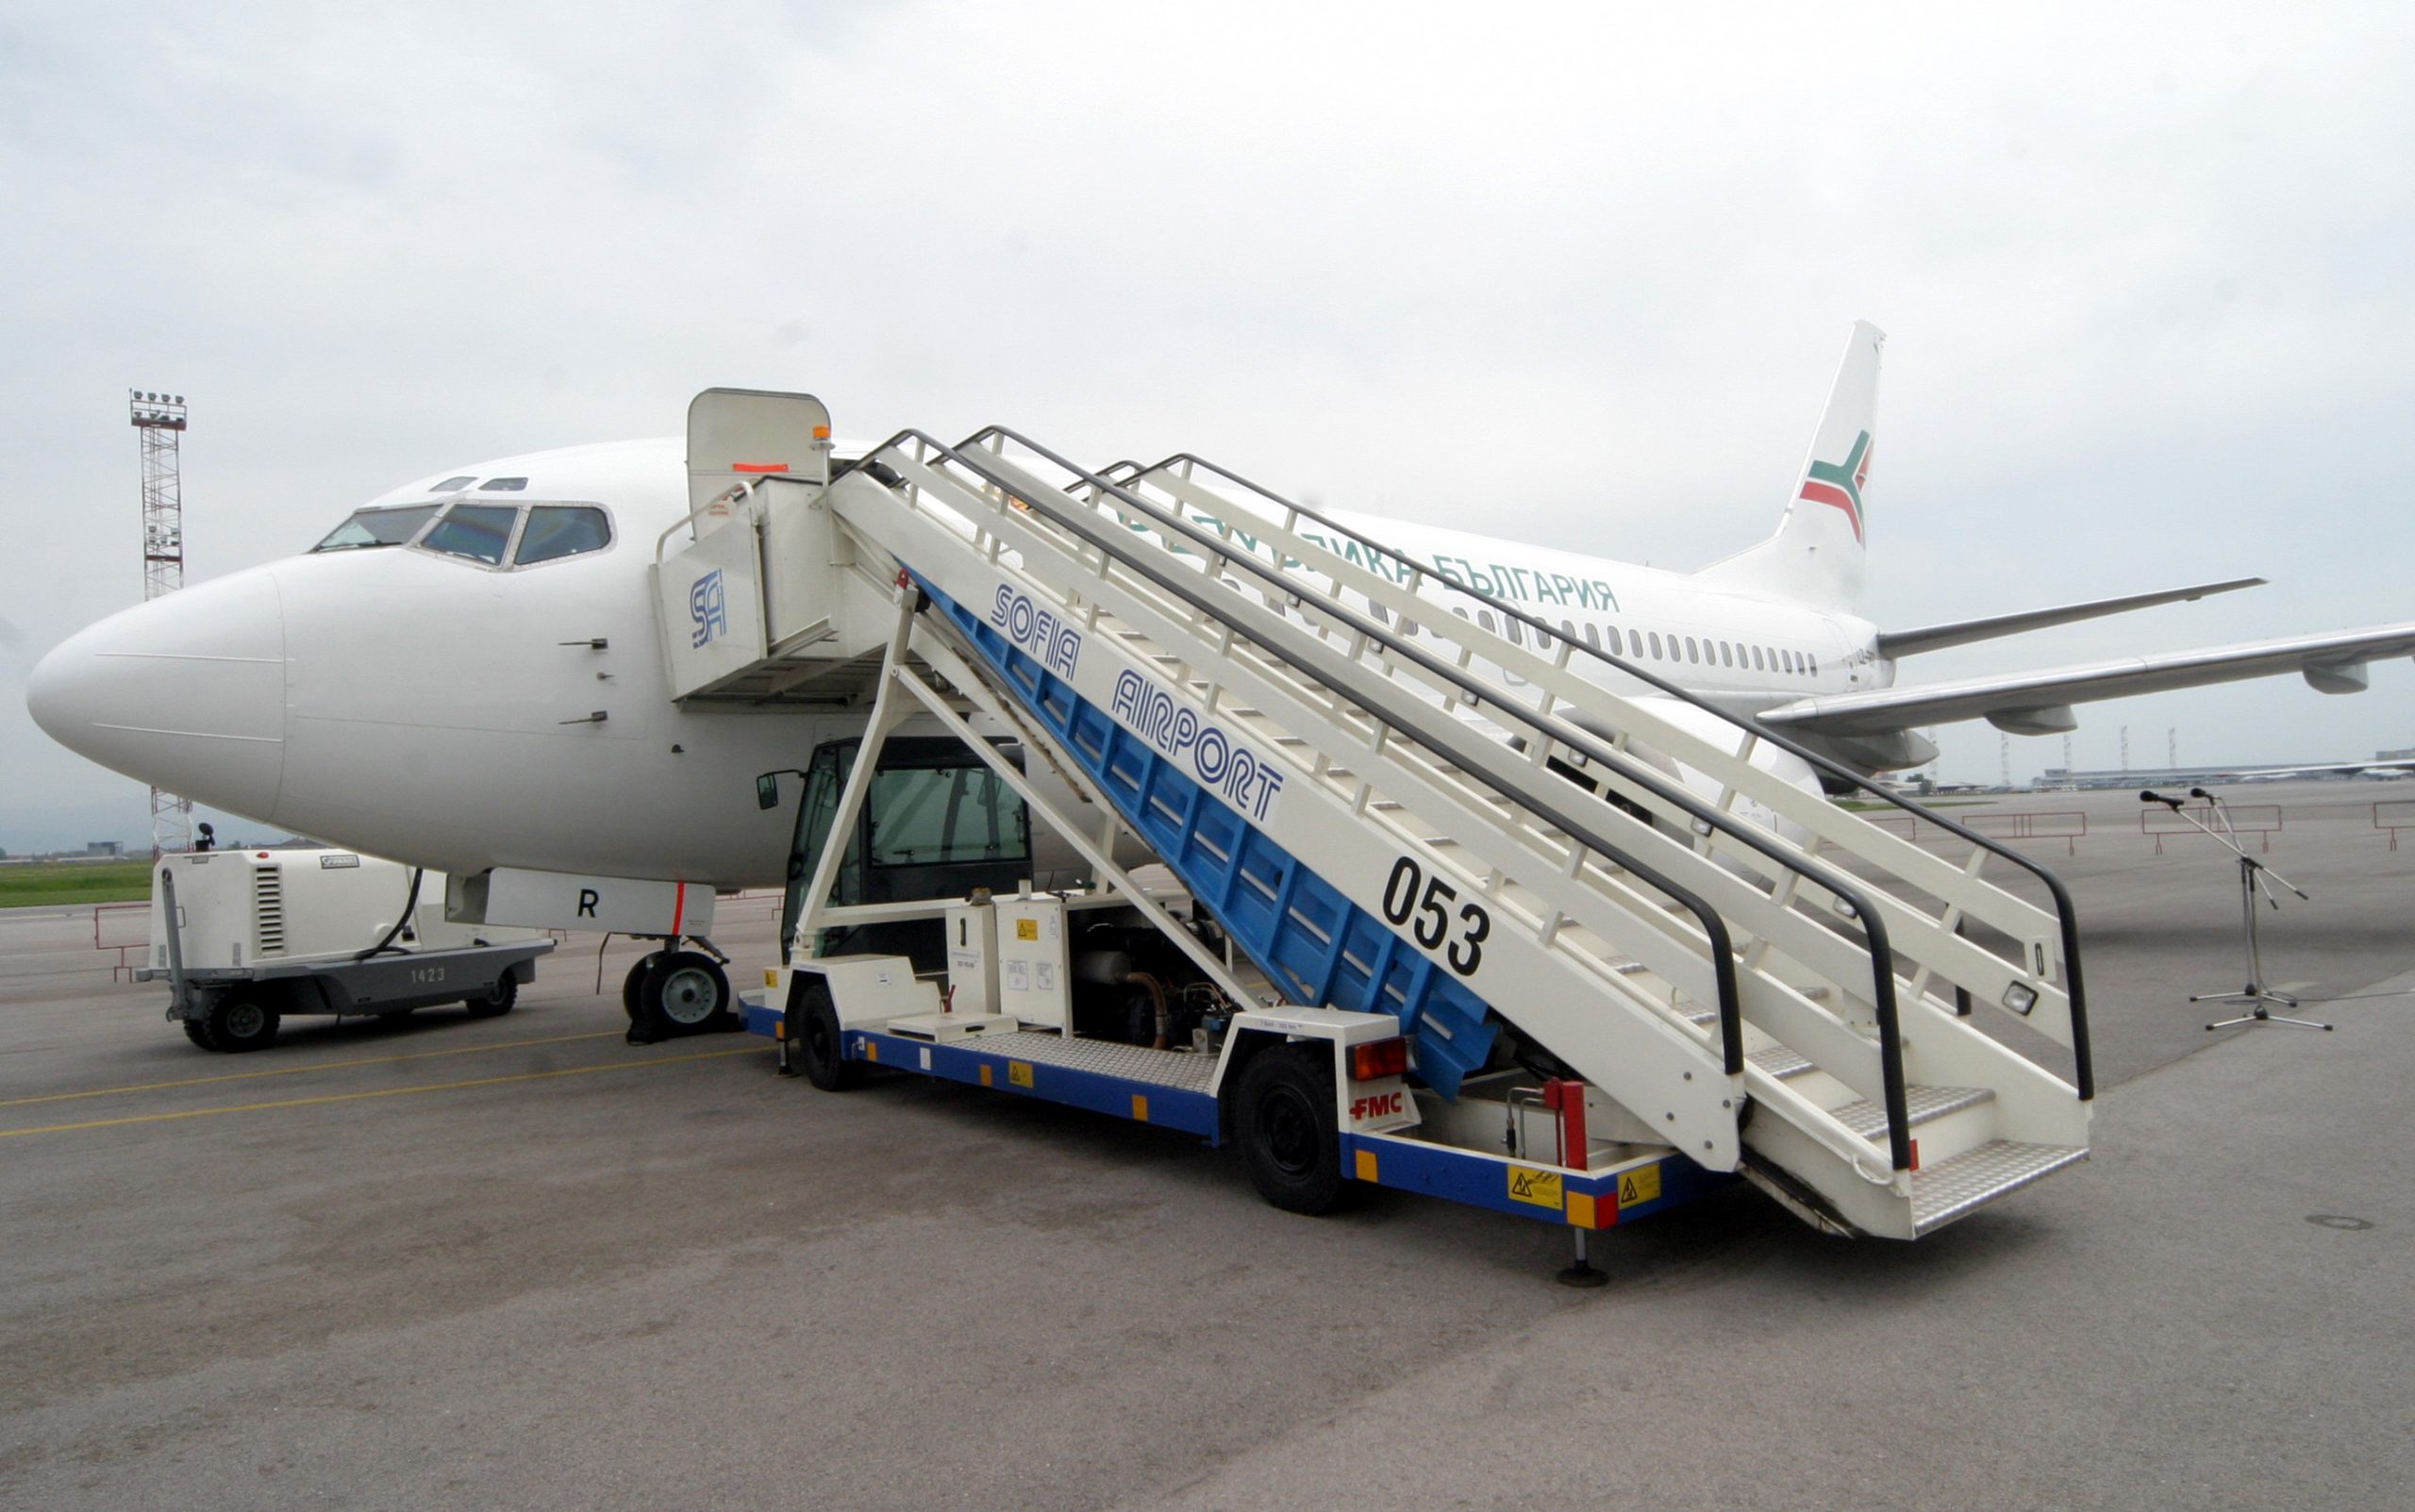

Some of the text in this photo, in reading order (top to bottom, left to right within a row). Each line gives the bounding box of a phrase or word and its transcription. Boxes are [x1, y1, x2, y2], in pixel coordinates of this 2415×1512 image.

[1431, 554, 1621, 612] БЪЛГАРИЯ
[991, 583, 1284, 822] SOFIA AIRPORT
[577, 889, 599, 918] R
[1382, 856, 1491, 976] 053
[410, 968, 445, 984] 1423
[1349, 1091, 1402, 1121] FMC
